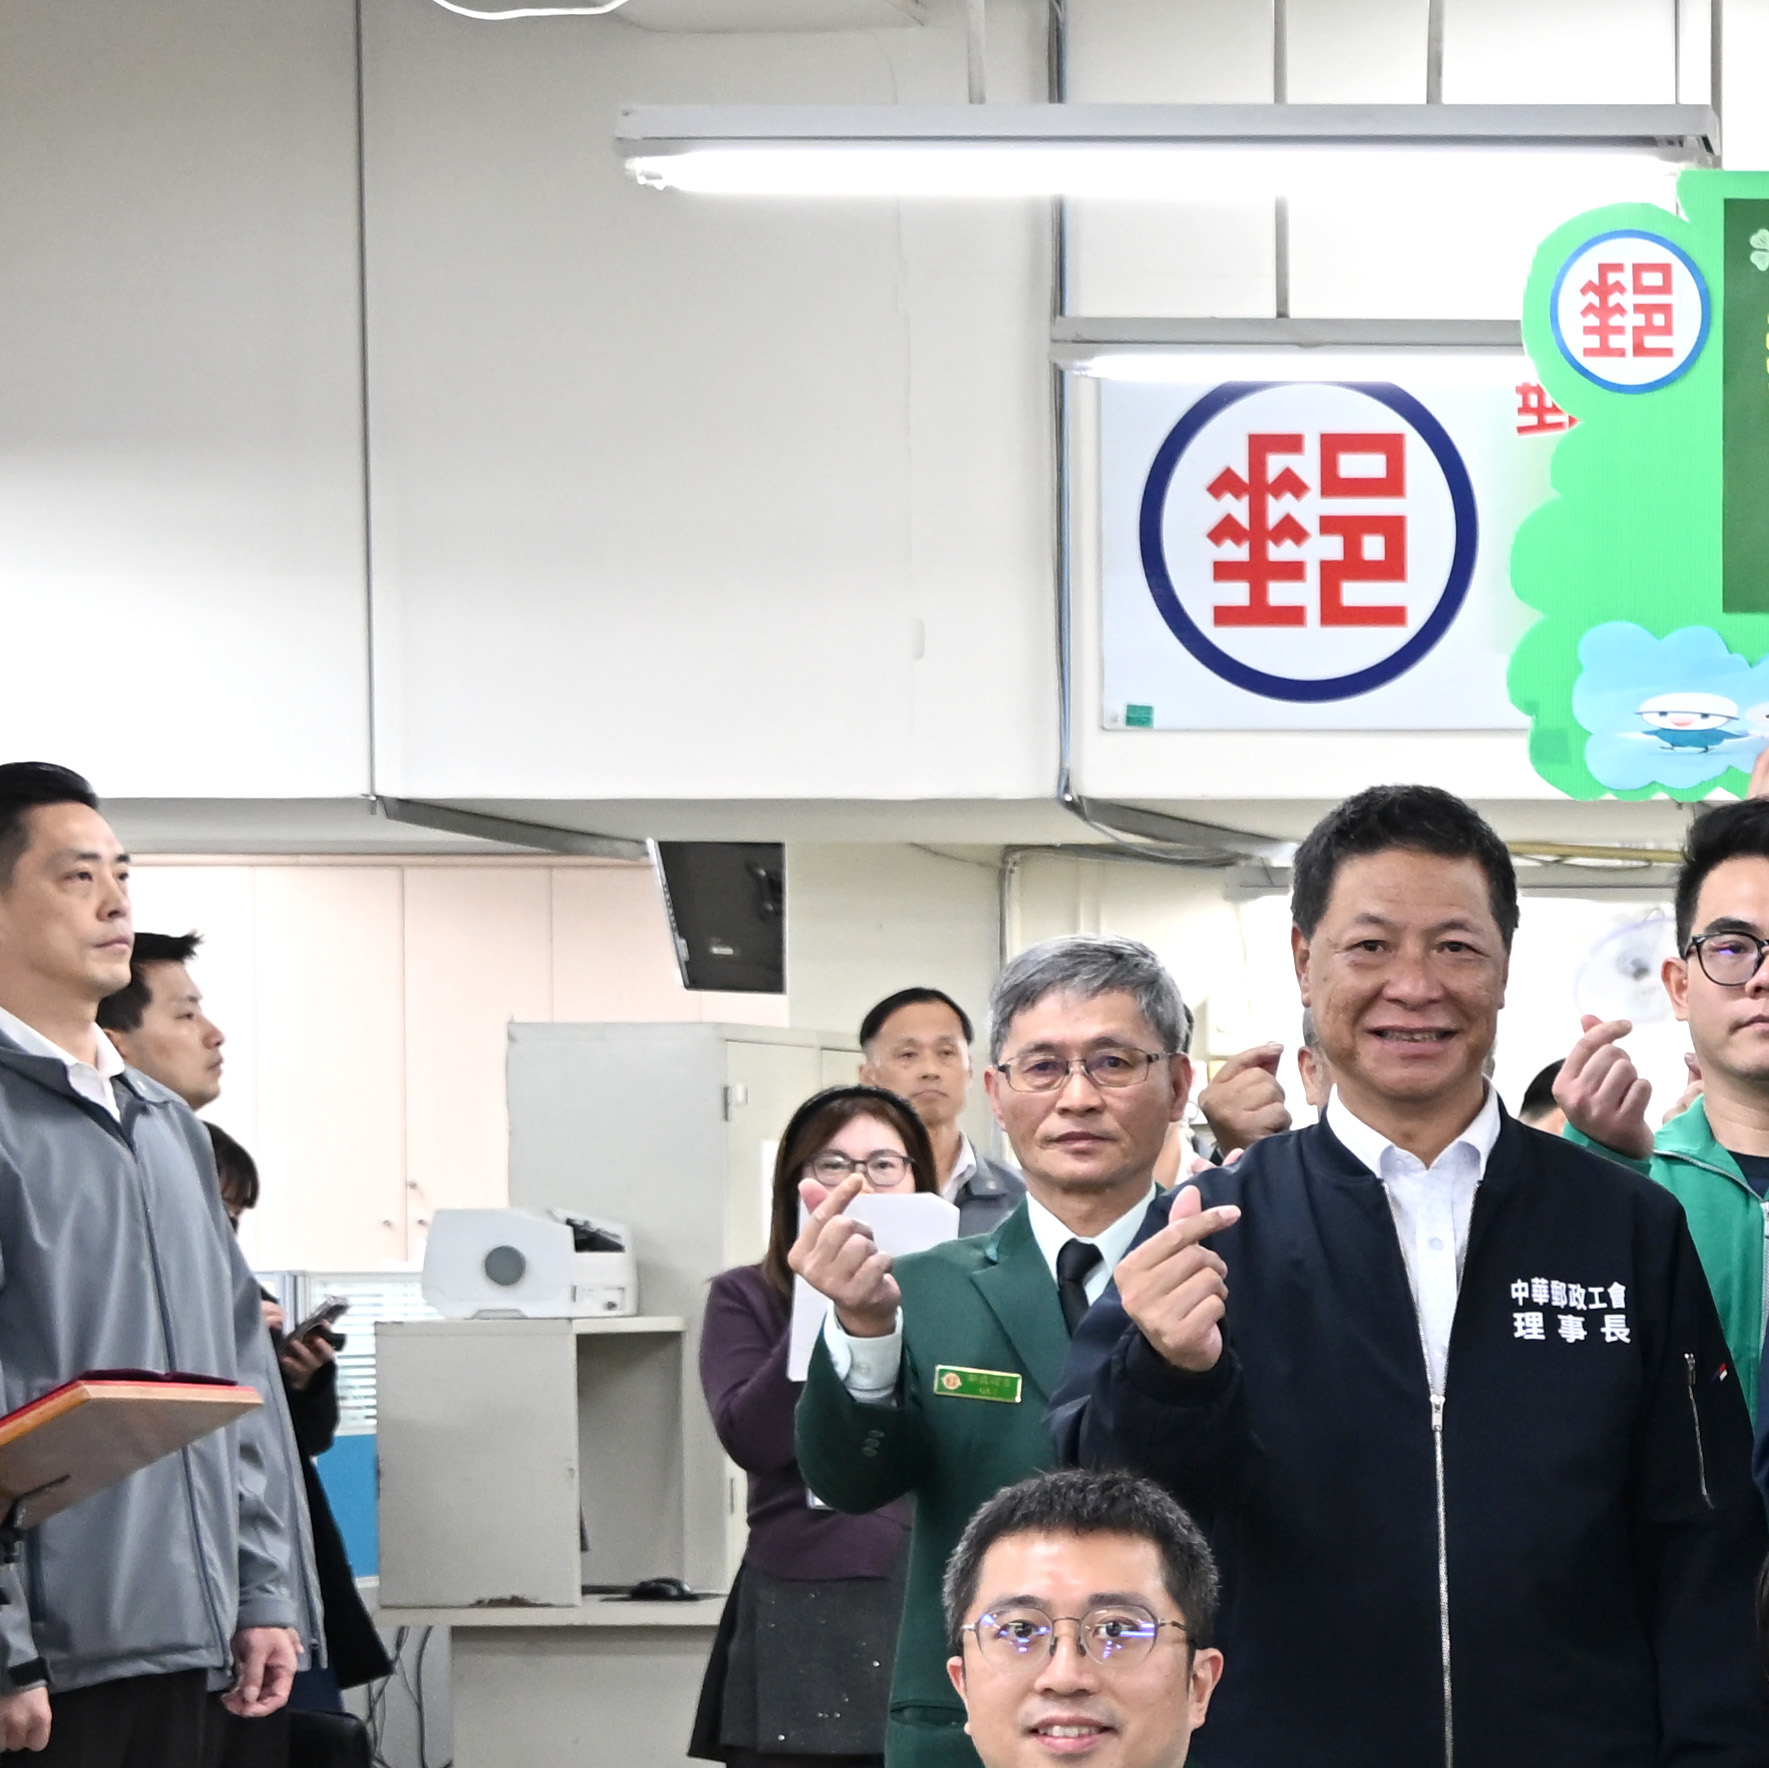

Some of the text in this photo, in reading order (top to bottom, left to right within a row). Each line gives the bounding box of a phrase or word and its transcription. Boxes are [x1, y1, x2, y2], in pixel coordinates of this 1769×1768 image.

[1579, 261, 1675, 358] 郵
[1205, 433, 1408, 628] 郵
[1510, 1277, 1627, 1311] 中華郵政工會
[1513, 1312, 1632, 1344] 理事長
